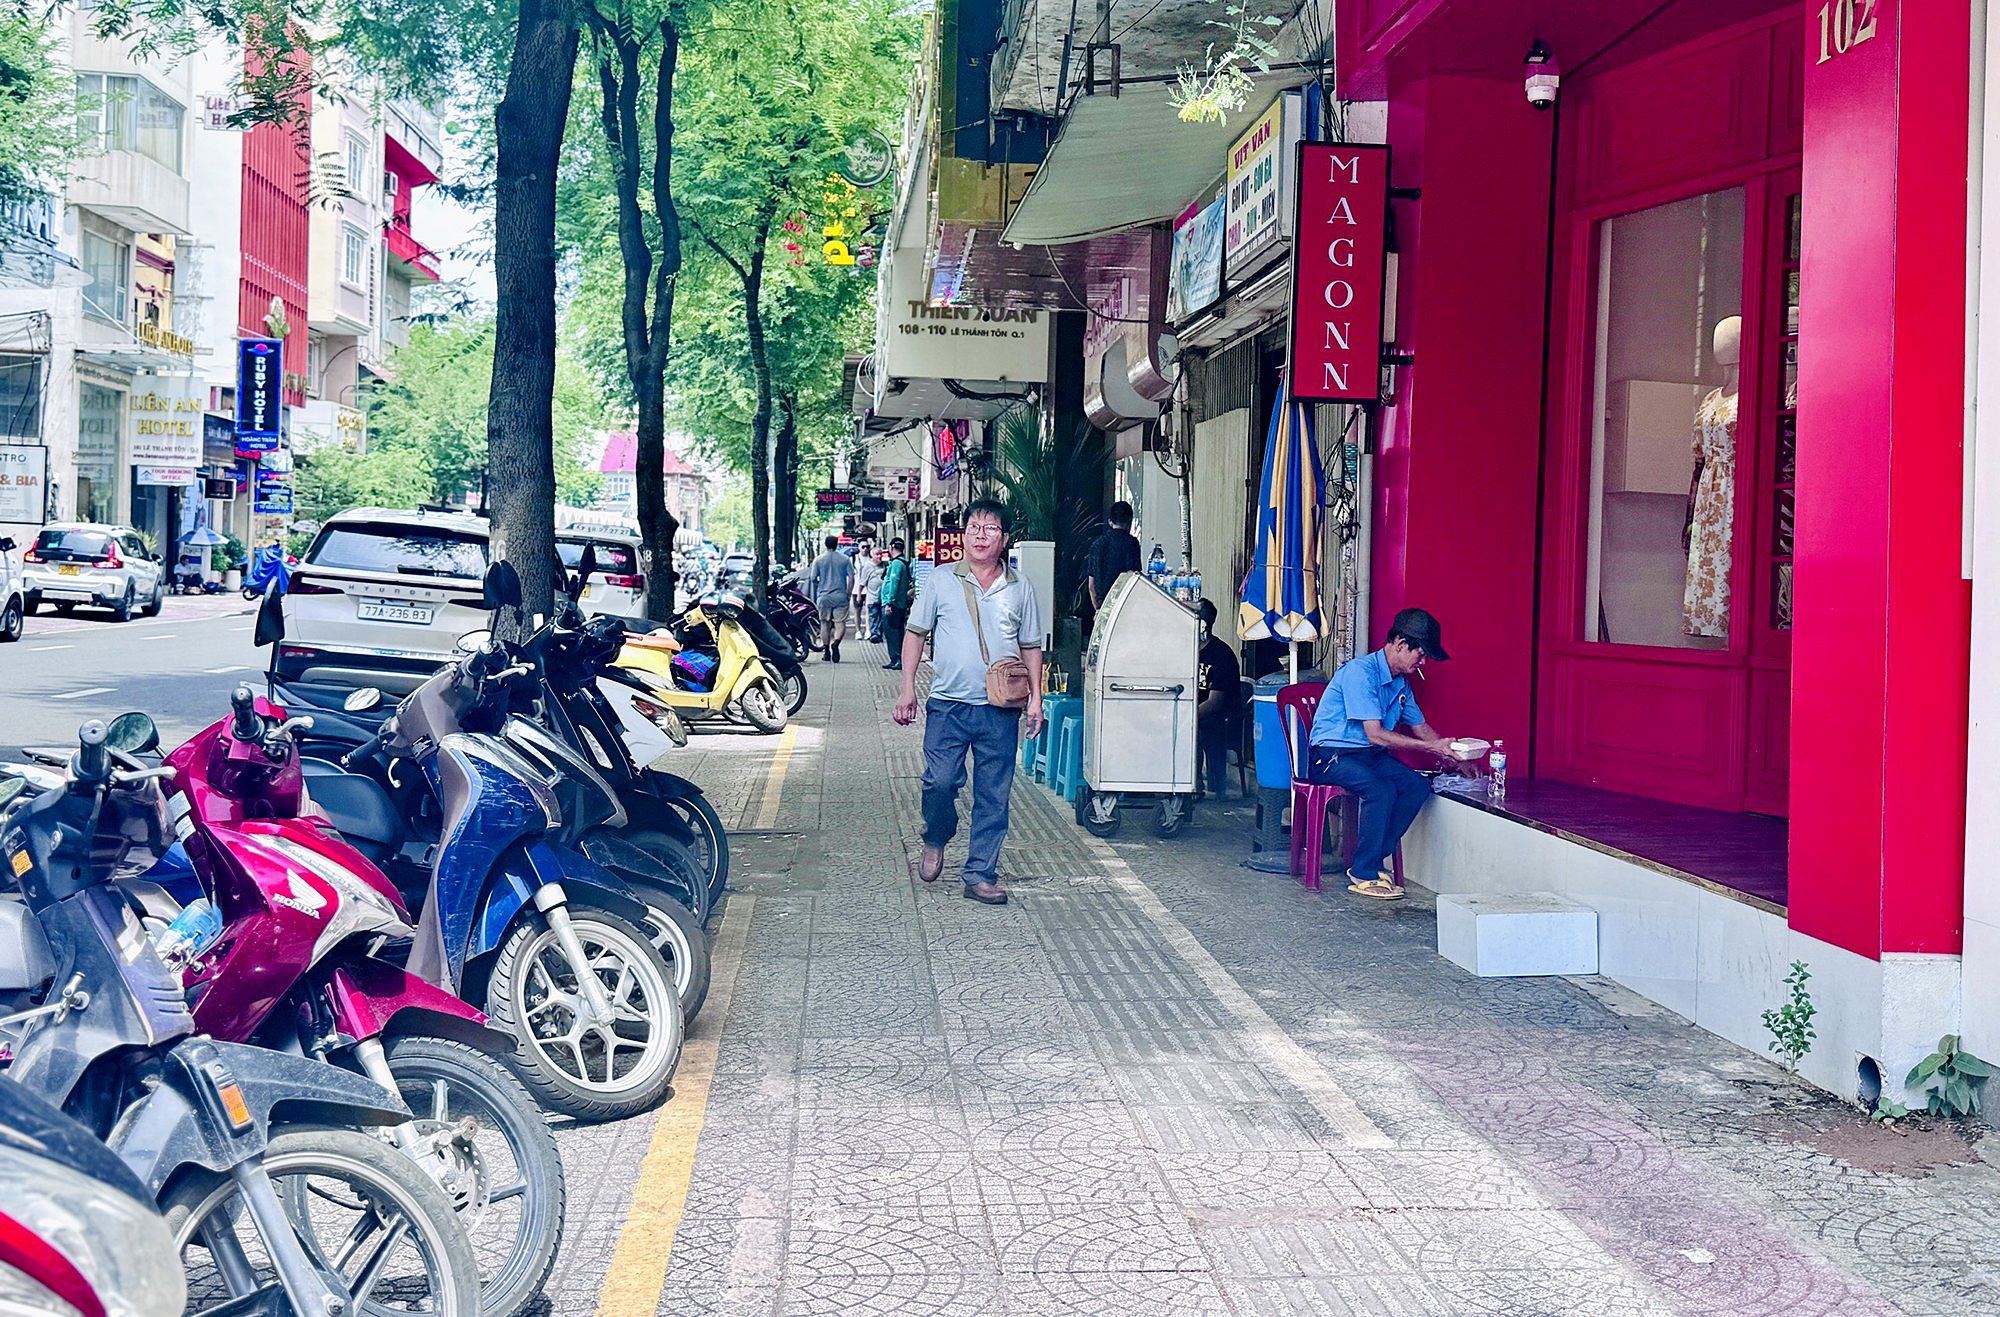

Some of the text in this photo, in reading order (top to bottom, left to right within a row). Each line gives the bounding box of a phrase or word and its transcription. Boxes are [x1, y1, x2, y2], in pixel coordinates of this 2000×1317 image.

[1816, 0, 1877, 65] 102
[1322, 155, 1360, 390] MAGONN
[899, 324, 919, 336] 108
[928, 325, 947, 336] 110
[131, 391, 171, 411] LIÊN
[174, 397, 202, 413] AN
[253, 356, 267, 431] RUBY HOTEL
[138, 419, 195, 437] HOTEL
[15, 475, 38, 486] BIA
[939, 546, 966, 560] ĐÔ
[348, 584, 445, 598] HYUNDAI
[272, 893, 321, 919] HONDA
